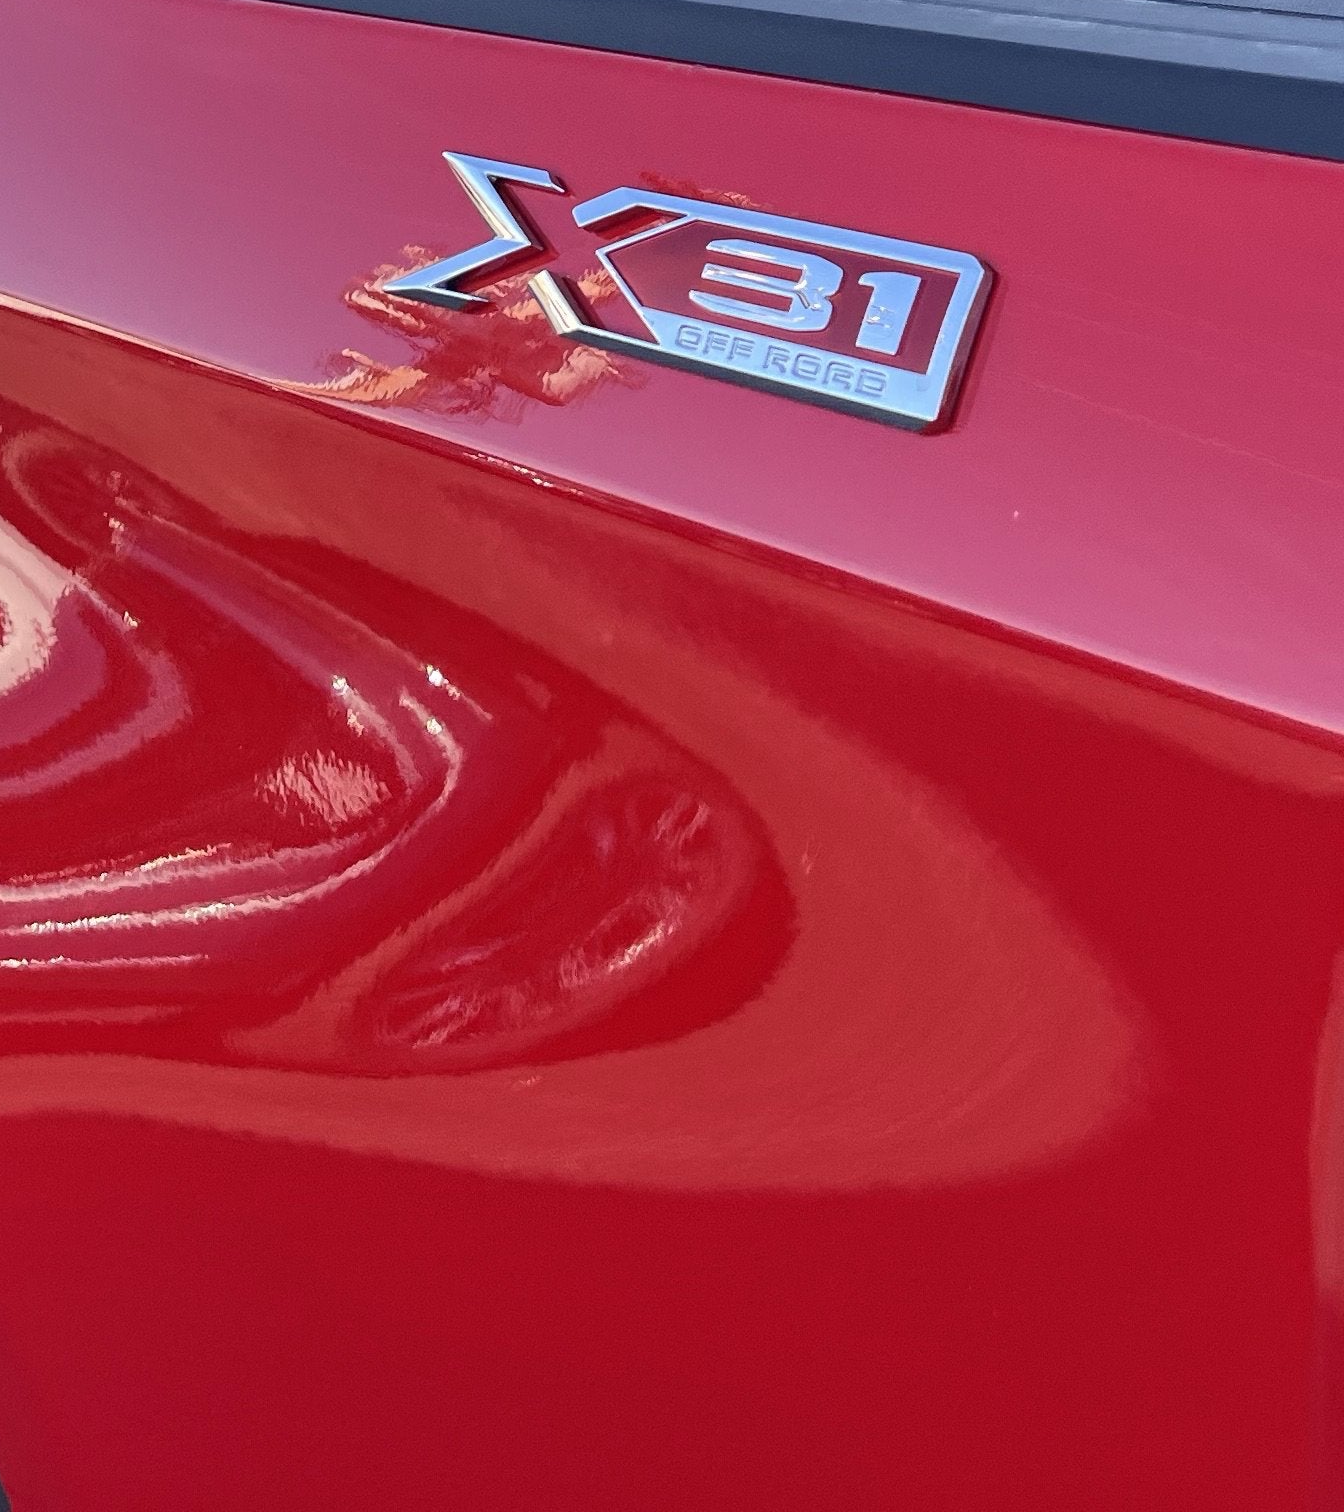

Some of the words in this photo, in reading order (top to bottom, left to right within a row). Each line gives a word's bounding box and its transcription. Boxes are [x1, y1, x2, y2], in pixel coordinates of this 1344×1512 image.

[382, 151, 922, 356] X31
[674, 324, 755, 361] OFF
[762, 344, 889, 397] ROAD
